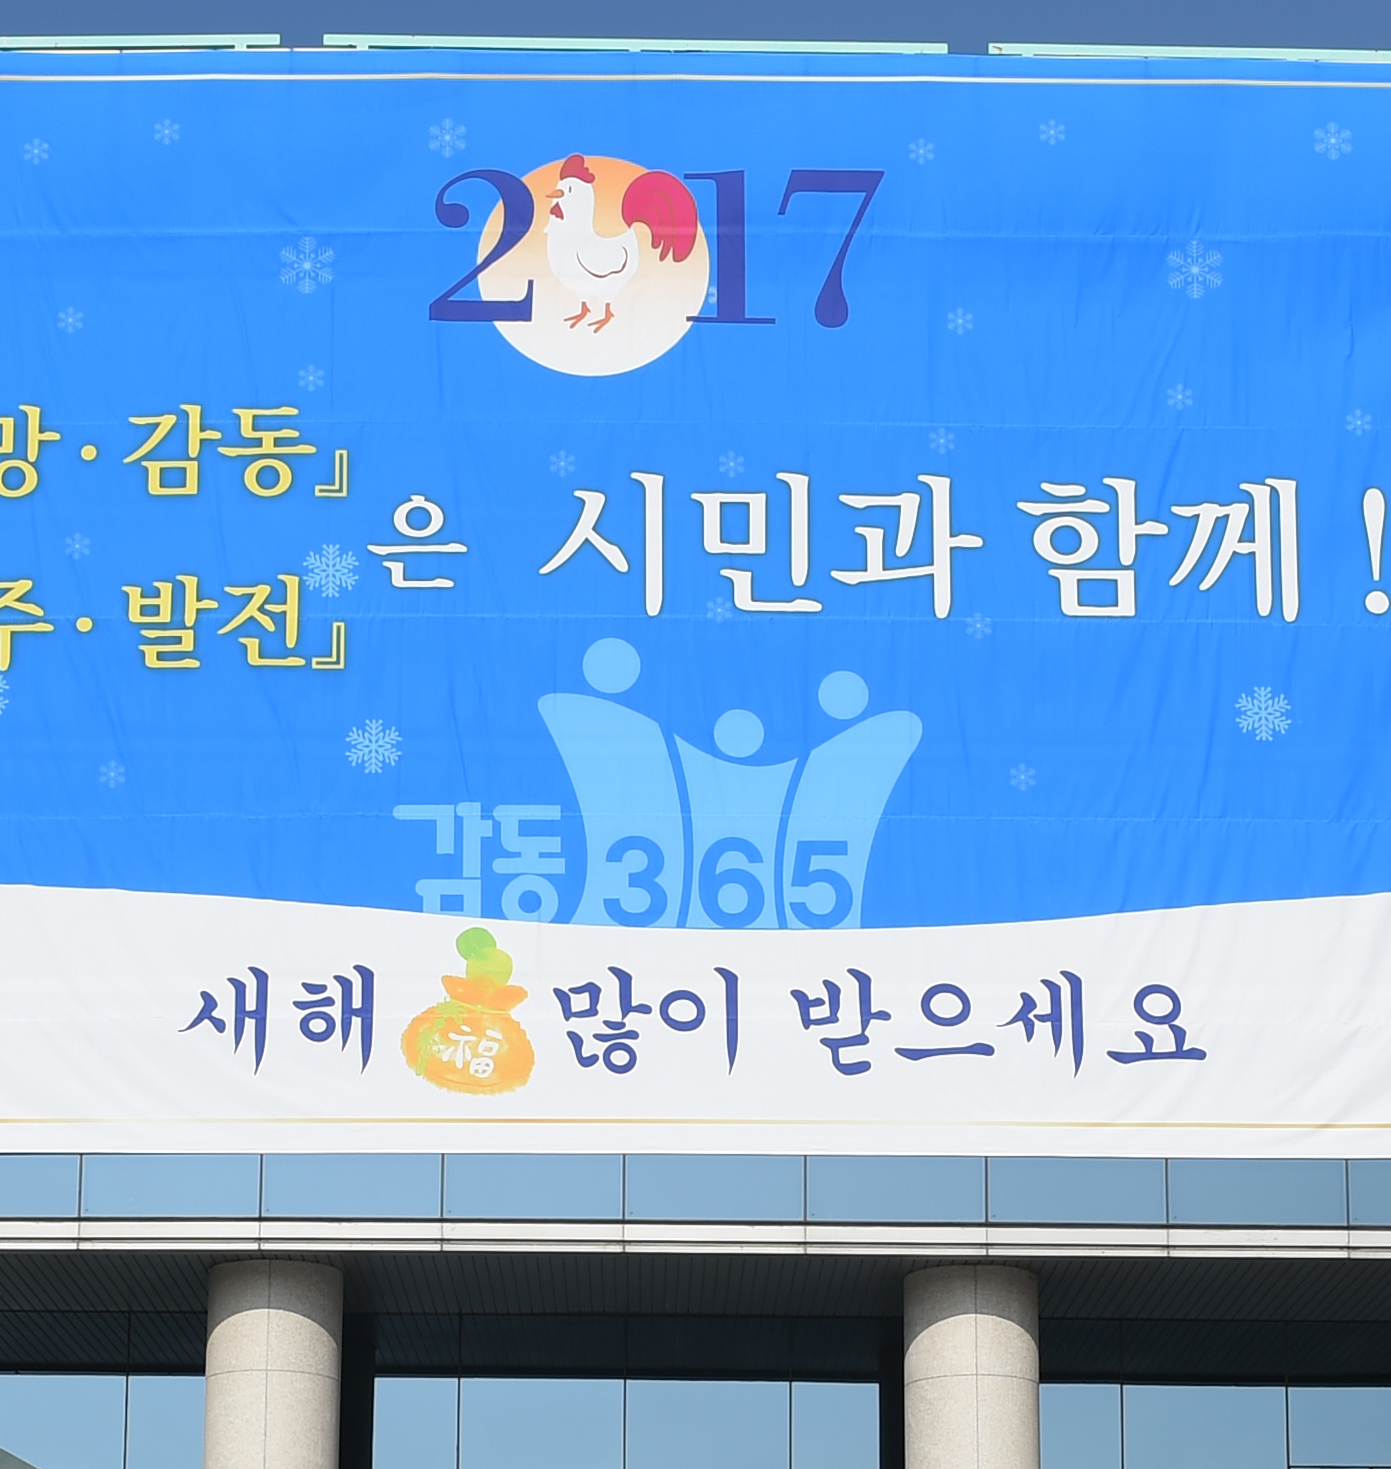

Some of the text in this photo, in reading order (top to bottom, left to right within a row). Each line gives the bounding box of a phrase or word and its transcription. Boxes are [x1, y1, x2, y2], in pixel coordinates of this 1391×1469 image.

[366, 493, 469, 590] 은
[538, 470, 985, 620] 시민과
[1016, 475, 1301, 624] 함께
[391, 801, 854, 929] 감동 365
[177, 964, 376, 1078] 새해
[552, 965, 740, 1076] 많이
[789, 967, 1208, 1079] 받으세요
